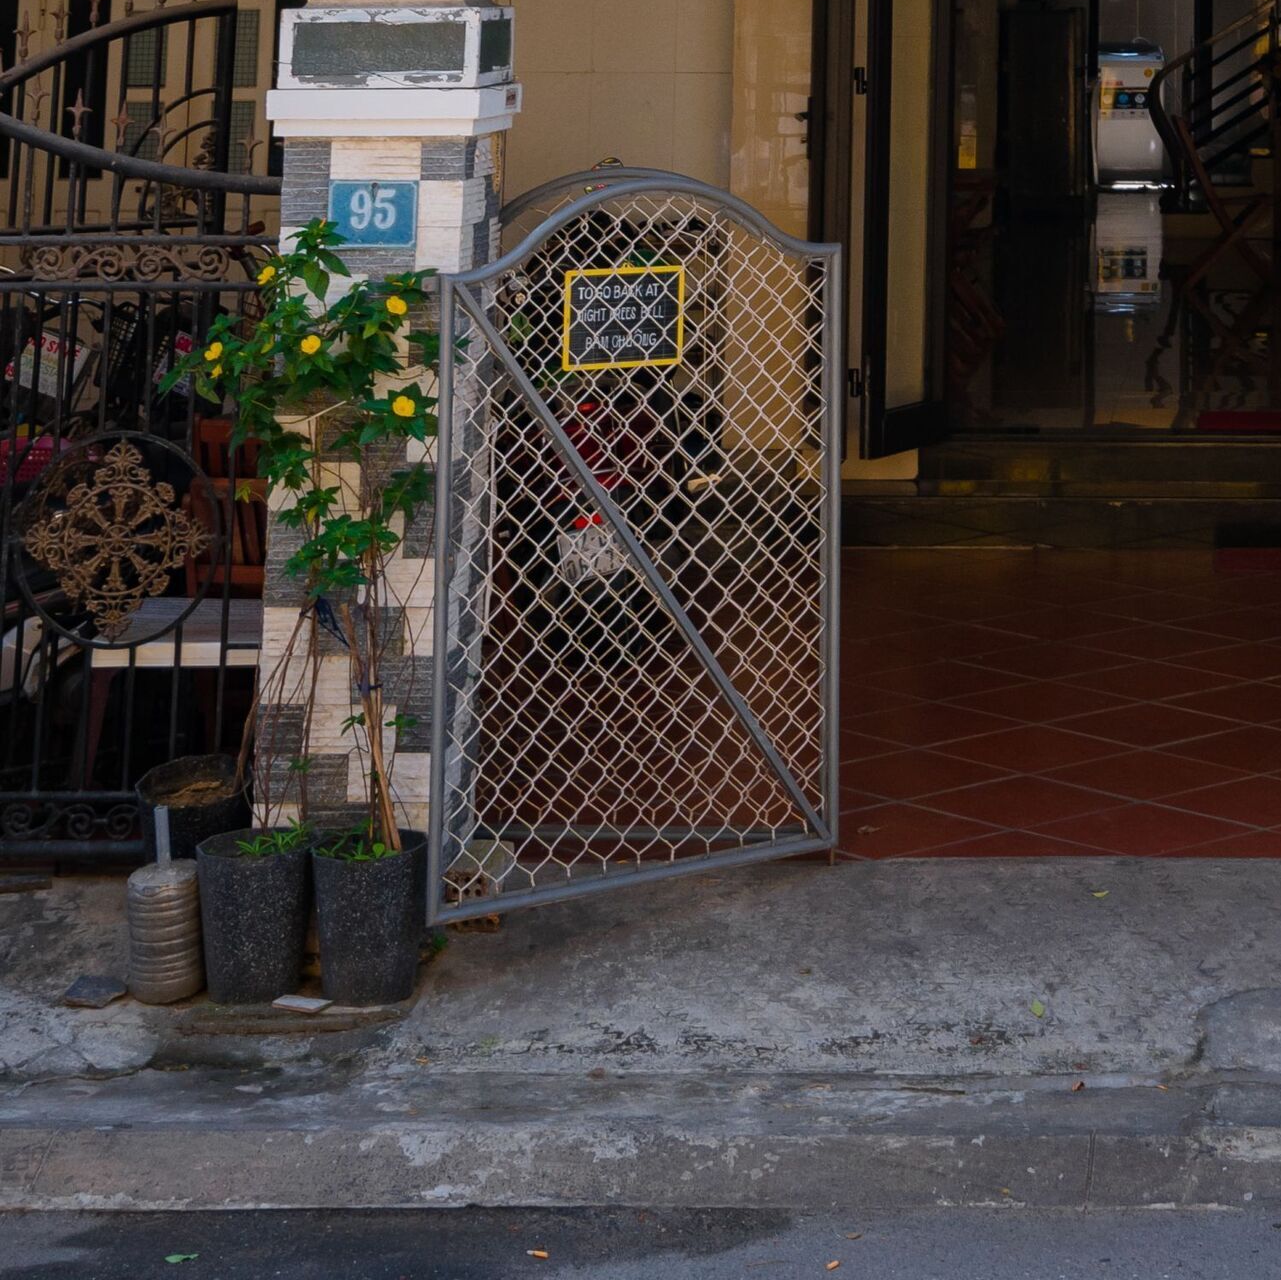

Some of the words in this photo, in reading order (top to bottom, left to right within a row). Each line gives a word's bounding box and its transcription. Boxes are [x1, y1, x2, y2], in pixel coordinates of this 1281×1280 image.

[350, 189, 396, 230] 95
[578, 287, 594, 300] TO
[645, 283, 660, 297] AT
